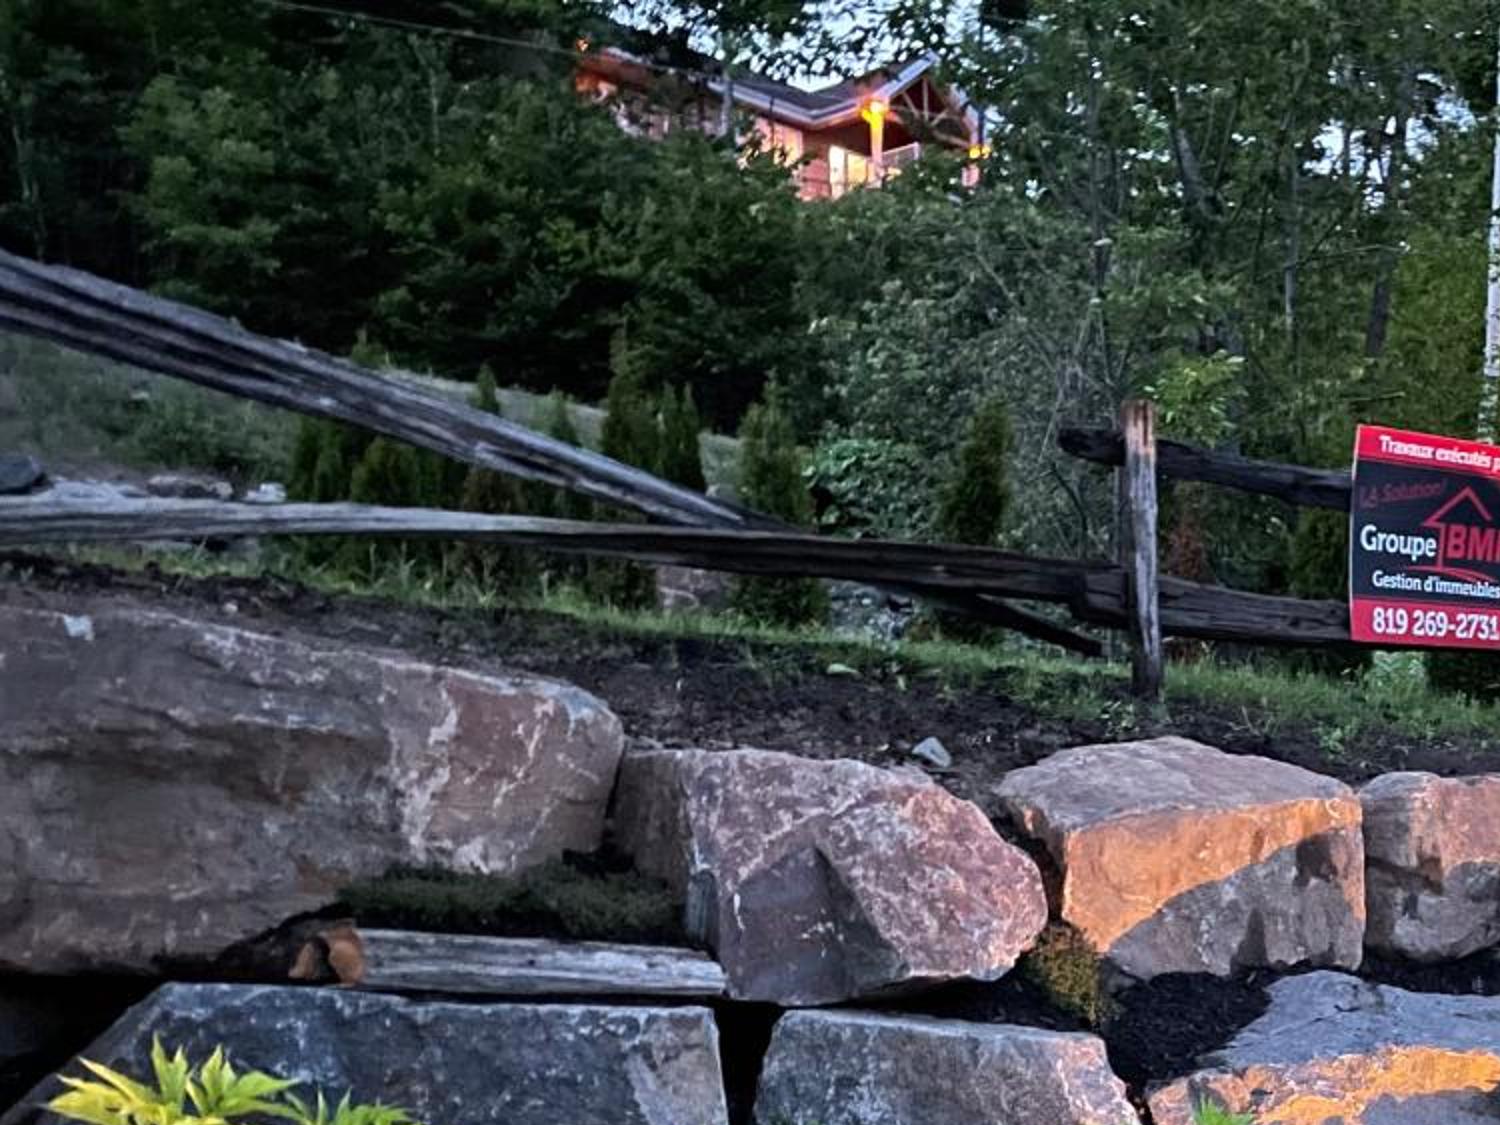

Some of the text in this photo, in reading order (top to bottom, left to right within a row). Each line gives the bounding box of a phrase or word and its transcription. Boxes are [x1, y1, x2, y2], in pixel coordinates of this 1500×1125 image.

[1379, 434, 1434, 459] Travaux
[1435, 446, 1491, 468] exécutés
[1360, 524, 1437, 562] Groupe
[1372, 570, 1422, 592] Gestion
[1372, 606, 1500, 640] 819 269-2731
